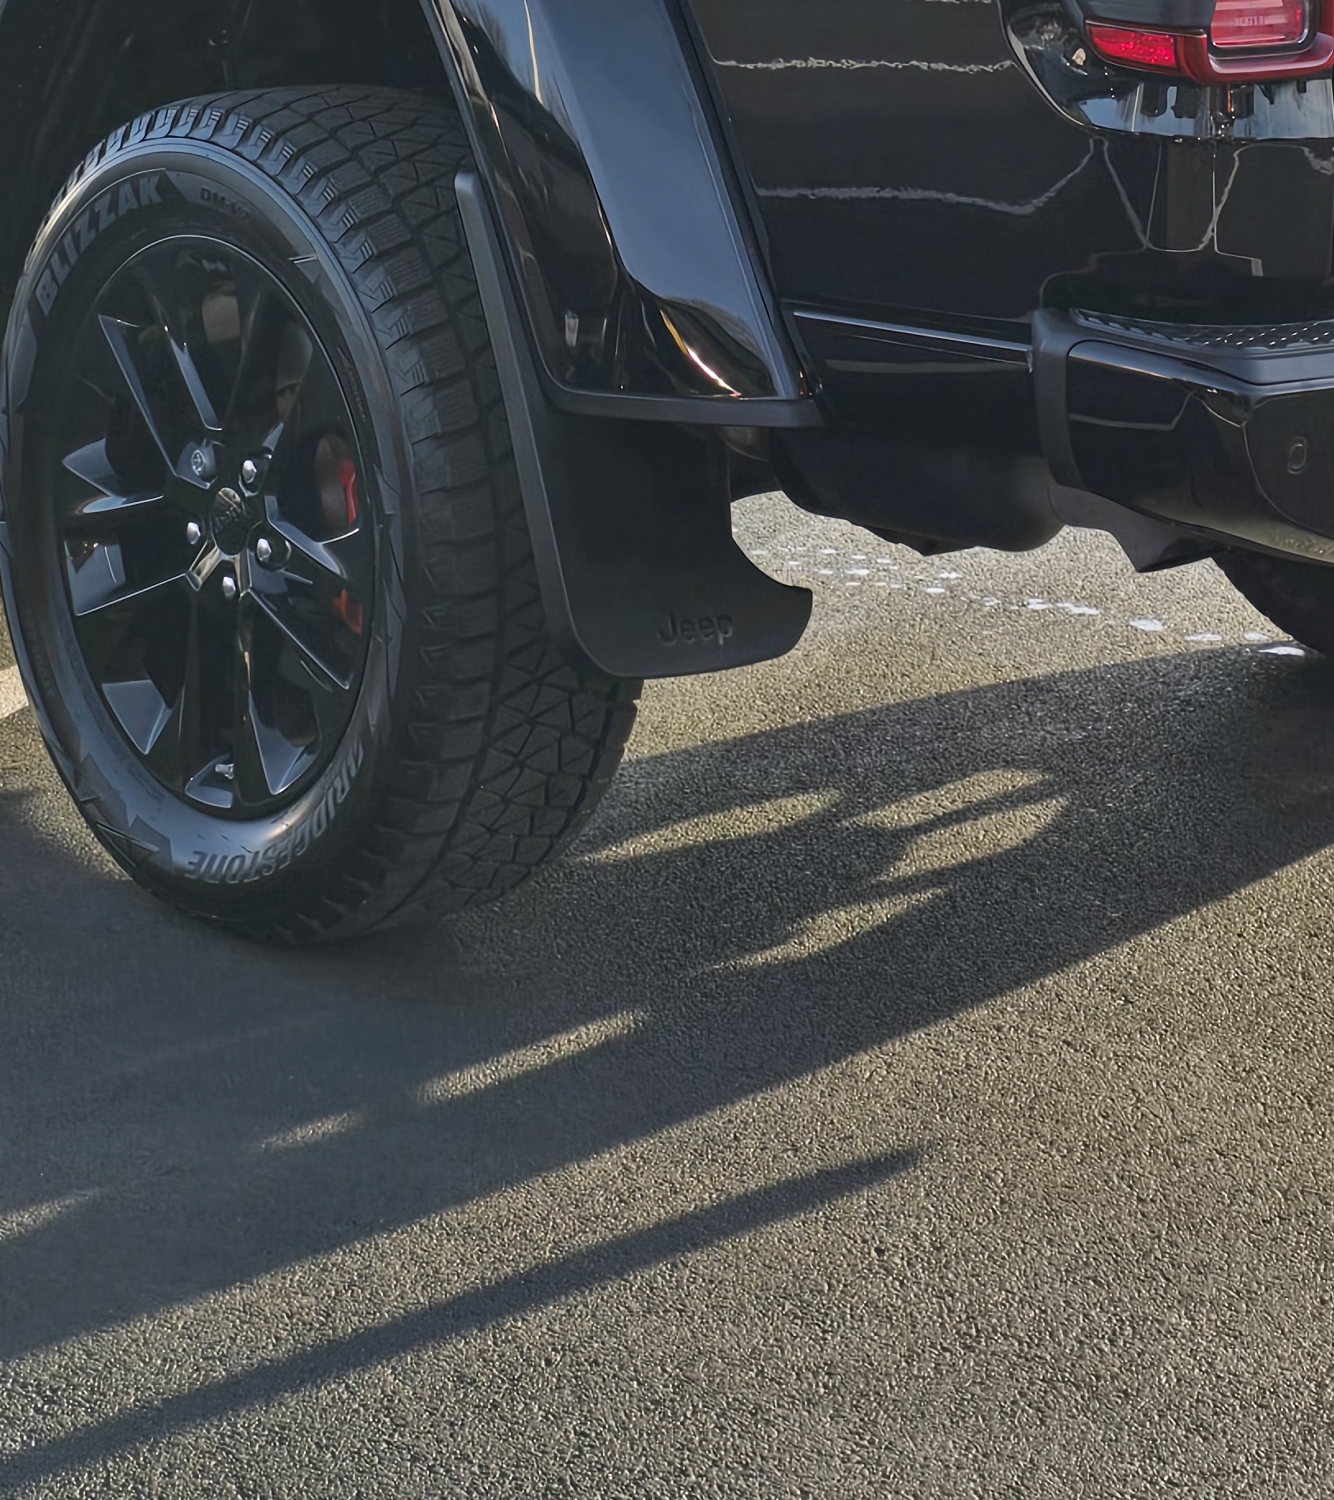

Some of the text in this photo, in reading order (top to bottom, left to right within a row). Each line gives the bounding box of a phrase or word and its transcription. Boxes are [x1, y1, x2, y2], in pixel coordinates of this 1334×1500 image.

[34, 174, 163, 318] BLIZZAK
[656, 612, 734, 646] Jeep
[184, 740, 364, 884] BRIDGESTONE
